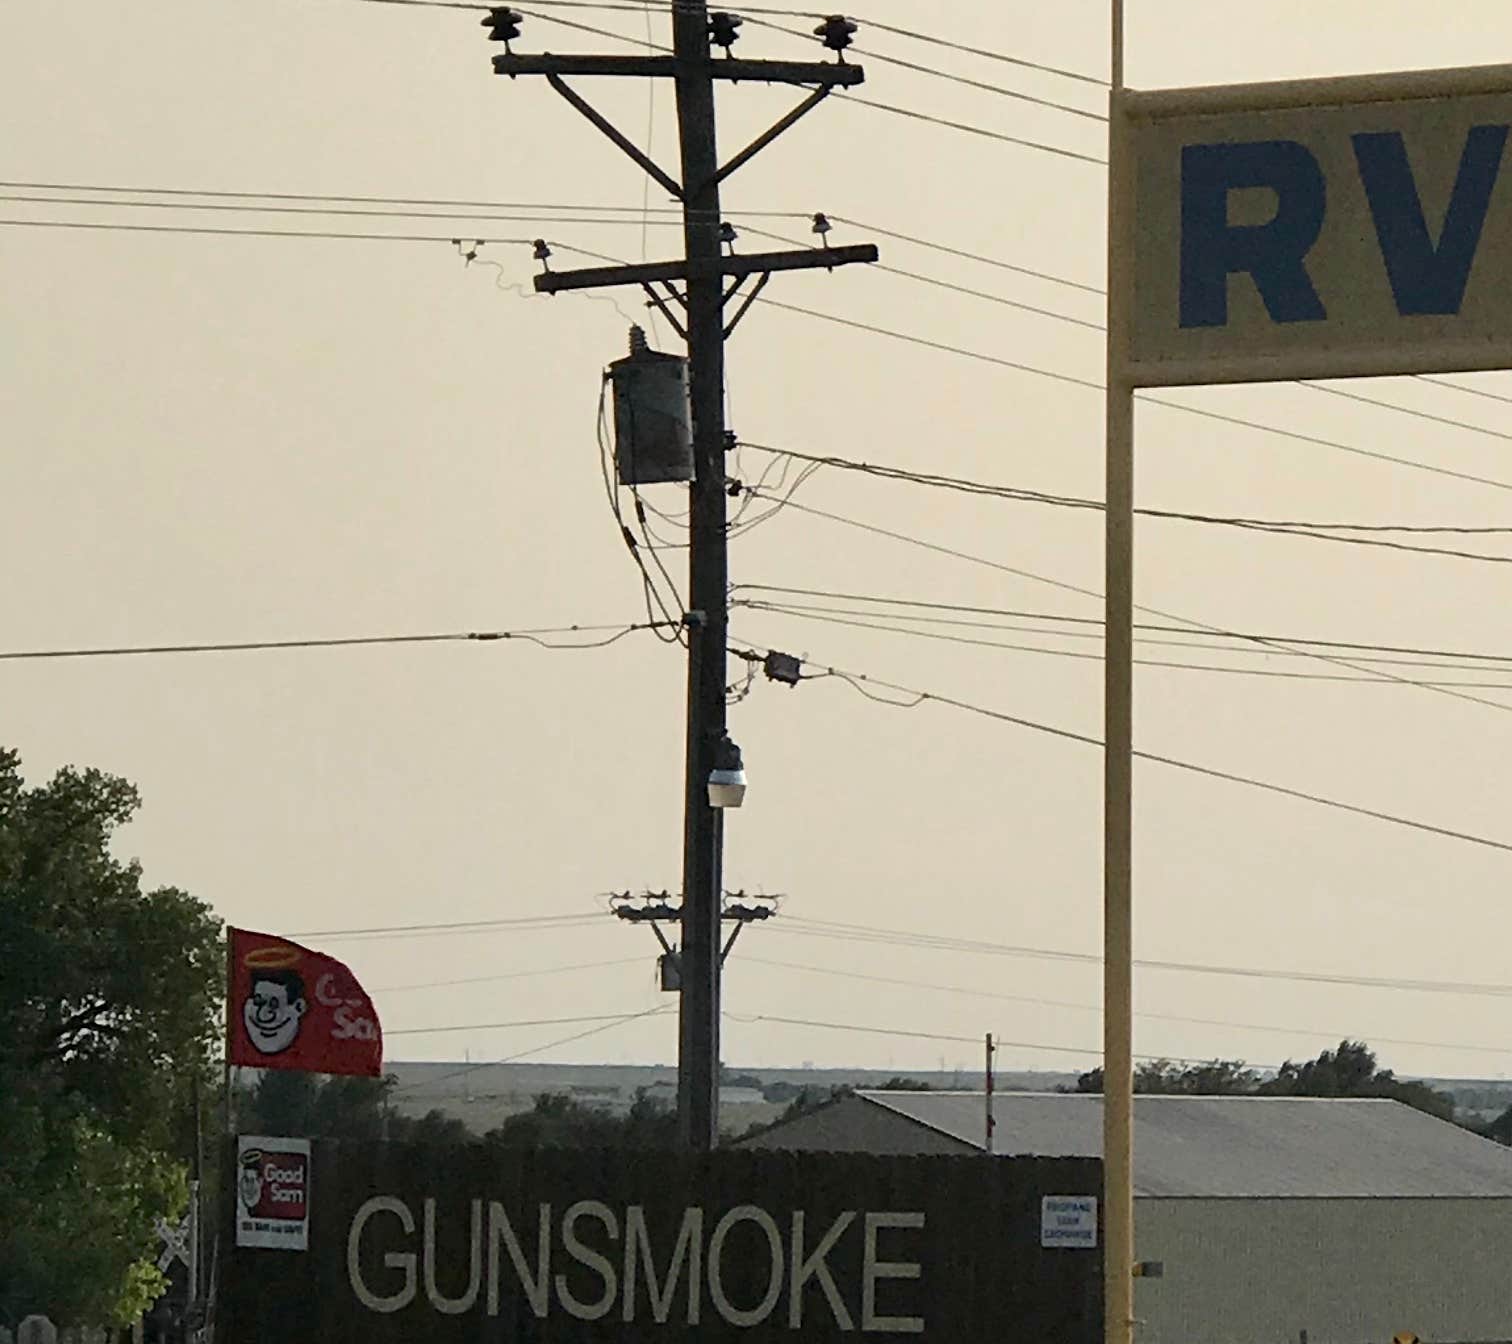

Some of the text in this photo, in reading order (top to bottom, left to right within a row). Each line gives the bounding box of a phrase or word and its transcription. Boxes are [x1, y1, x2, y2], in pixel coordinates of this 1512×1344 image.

[1178, 123, 1510, 329] RV
[264, 1163, 304, 1183] Good
[271, 1183, 304, 1203] Sam
[347, 1195, 926, 1333] GUNSMOKE
